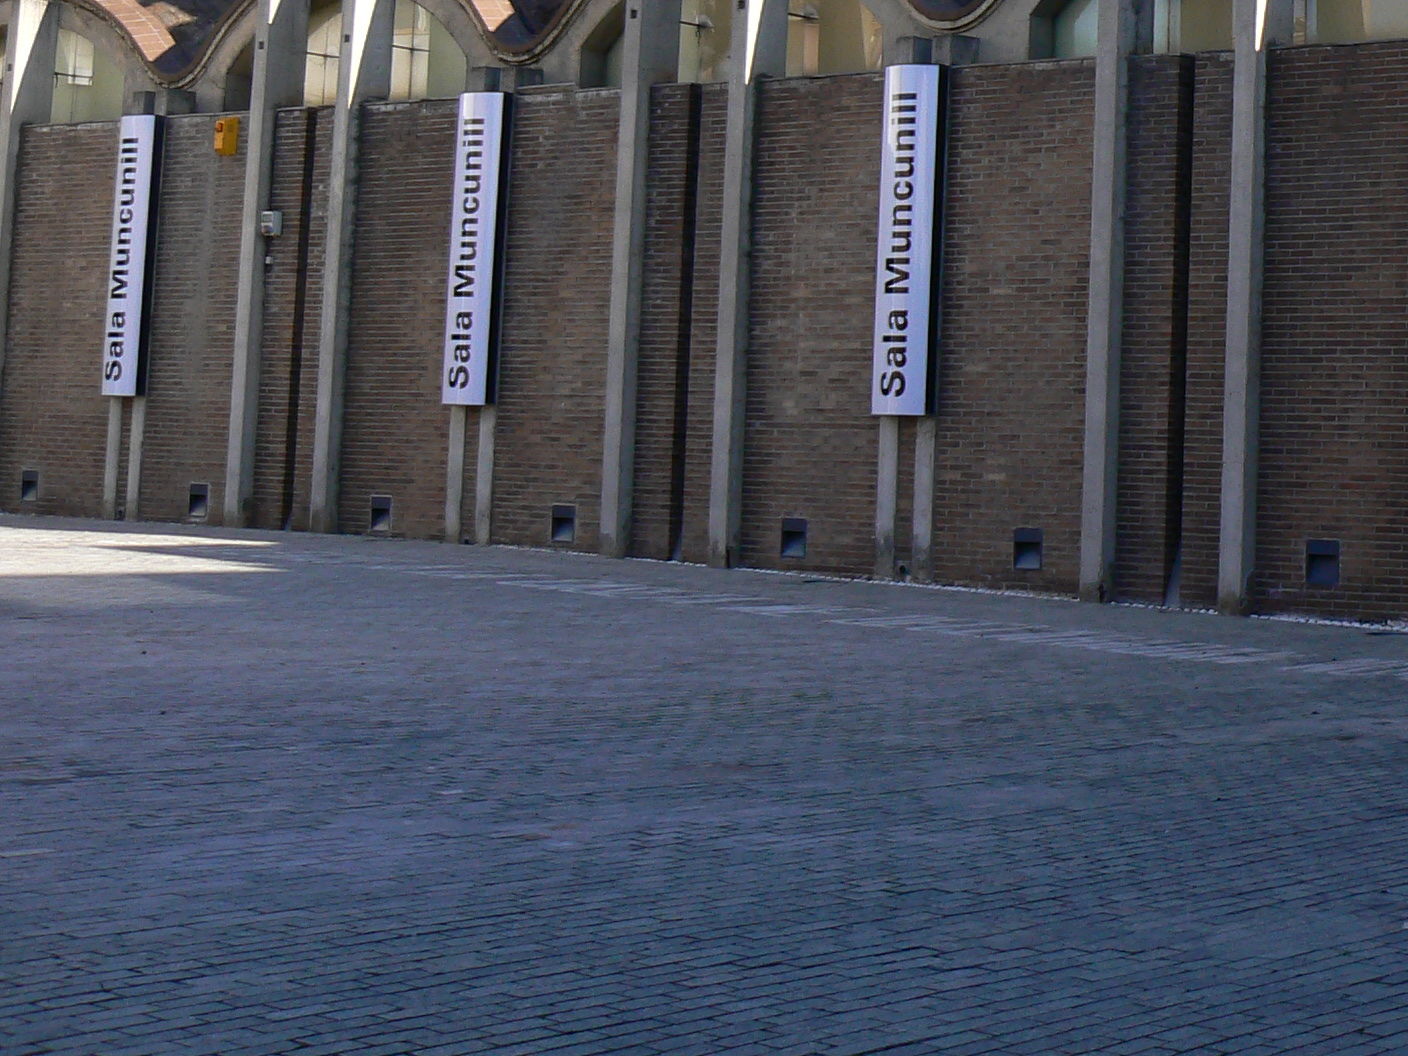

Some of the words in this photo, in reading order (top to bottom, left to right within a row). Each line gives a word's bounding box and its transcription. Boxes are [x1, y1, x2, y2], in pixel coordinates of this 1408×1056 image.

[111, 137, 139, 300] Muncunill
[453, 118, 485, 298] Muncunill
[884, 92, 917, 295] Muncunill
[105, 311, 126, 381] Sala
[448, 311, 473, 389] Sala
[881, 310, 908, 398] Sala
